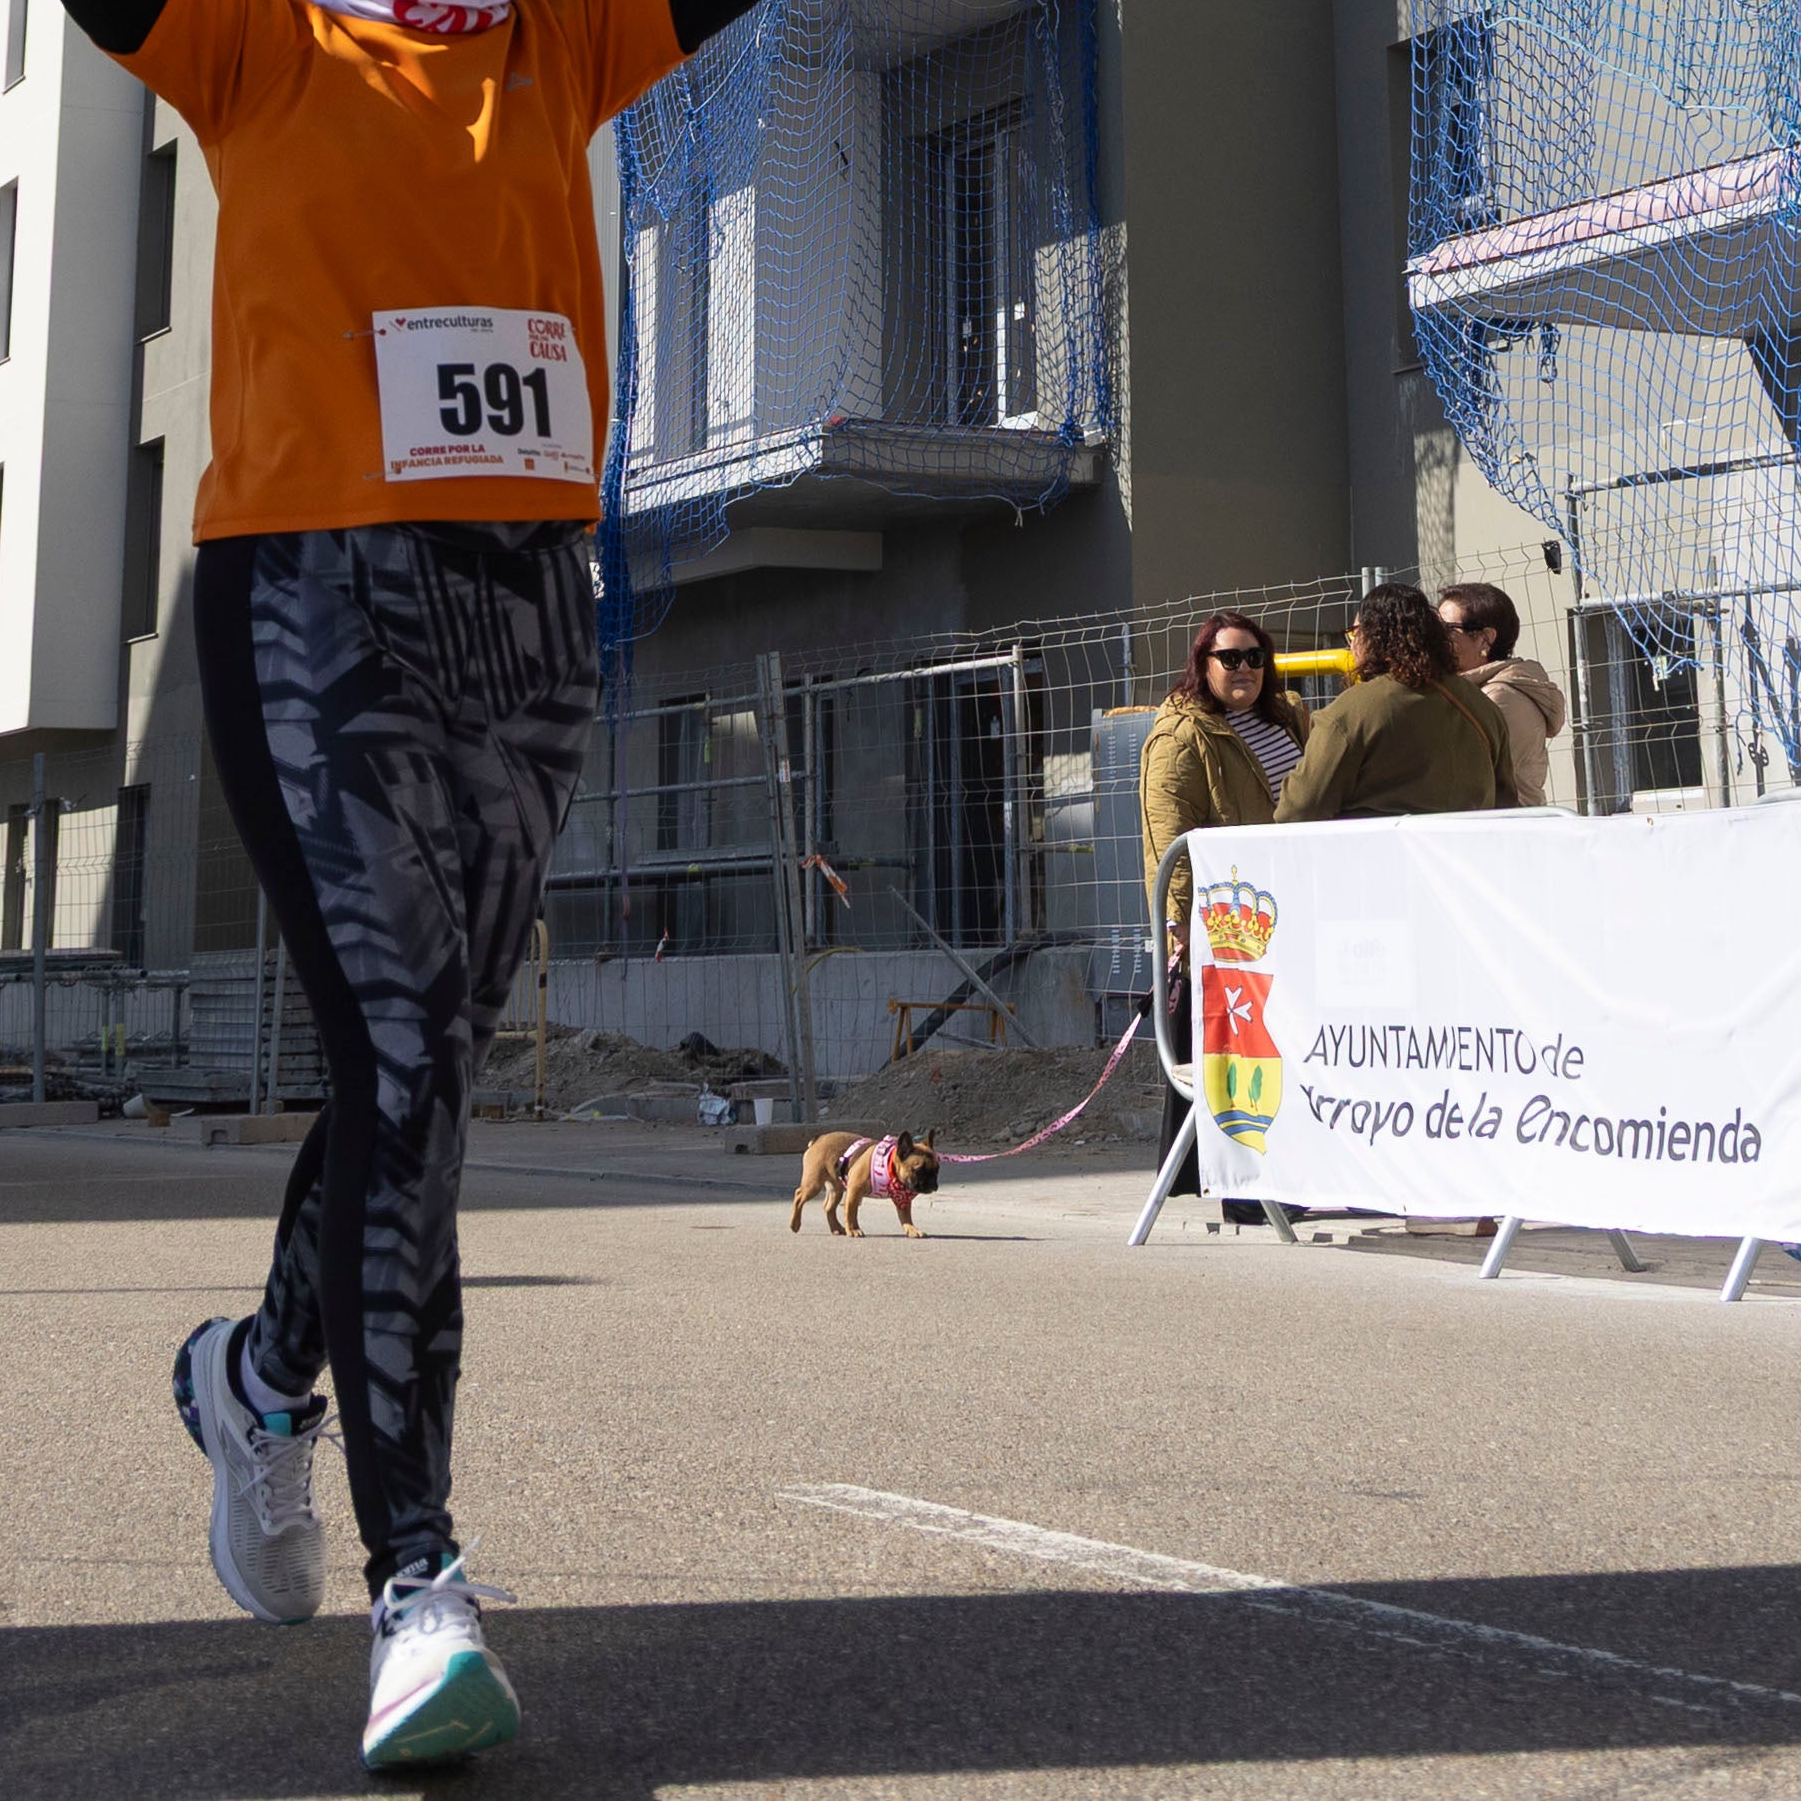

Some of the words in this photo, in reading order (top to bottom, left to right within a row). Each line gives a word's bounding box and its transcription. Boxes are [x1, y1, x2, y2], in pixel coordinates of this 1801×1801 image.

[406, 315, 494, 331] entreculturas
[527, 318, 567, 340] CORRE
[530, 341, 568, 363] CAUSA
[436, 362, 552, 439] 591
[409, 444, 446, 456] CORRE
[447, 443, 469, 455] POR
[470, 443, 486, 454] LA
[444, 453, 504, 466] REFUGIADA
[1302, 1024, 1536, 1076] AYUNTAMIENTO
[1540, 1032, 1586, 1080] de
[1425, 1088, 1464, 1140] de
[1466, 1091, 1504, 1140] la
